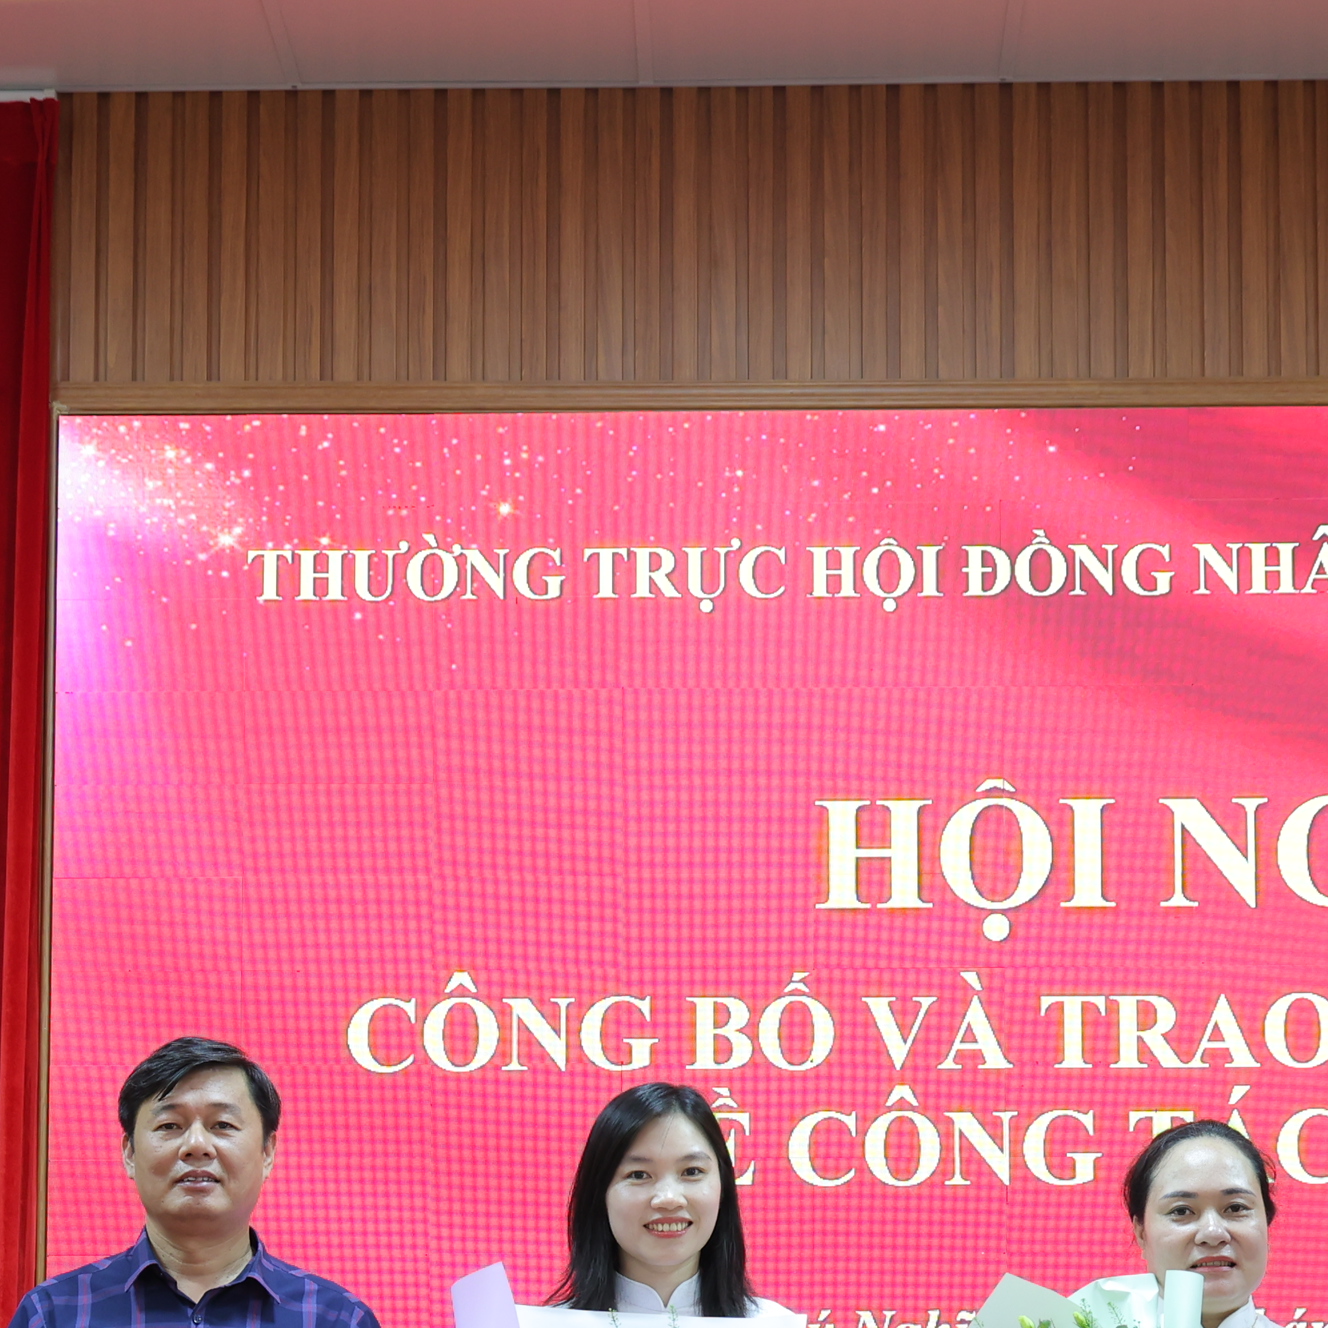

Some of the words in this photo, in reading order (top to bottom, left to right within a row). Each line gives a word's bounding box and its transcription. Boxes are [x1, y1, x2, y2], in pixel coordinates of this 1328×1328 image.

[247, 532, 565, 604] THƯỜNG
[583, 537, 786, 613] TRỰC
[805, 537, 944, 612] HỘI
[961, 529, 1175, 600] ĐỒNG
[814, 778, 1117, 943] HỘI
[347, 971, 659, 1074] CÔNG
[685, 966, 835, 1072] BỐ
[861, 966, 1014, 1072] VÀ
[787, 1083, 1103, 1187] CÔNG
